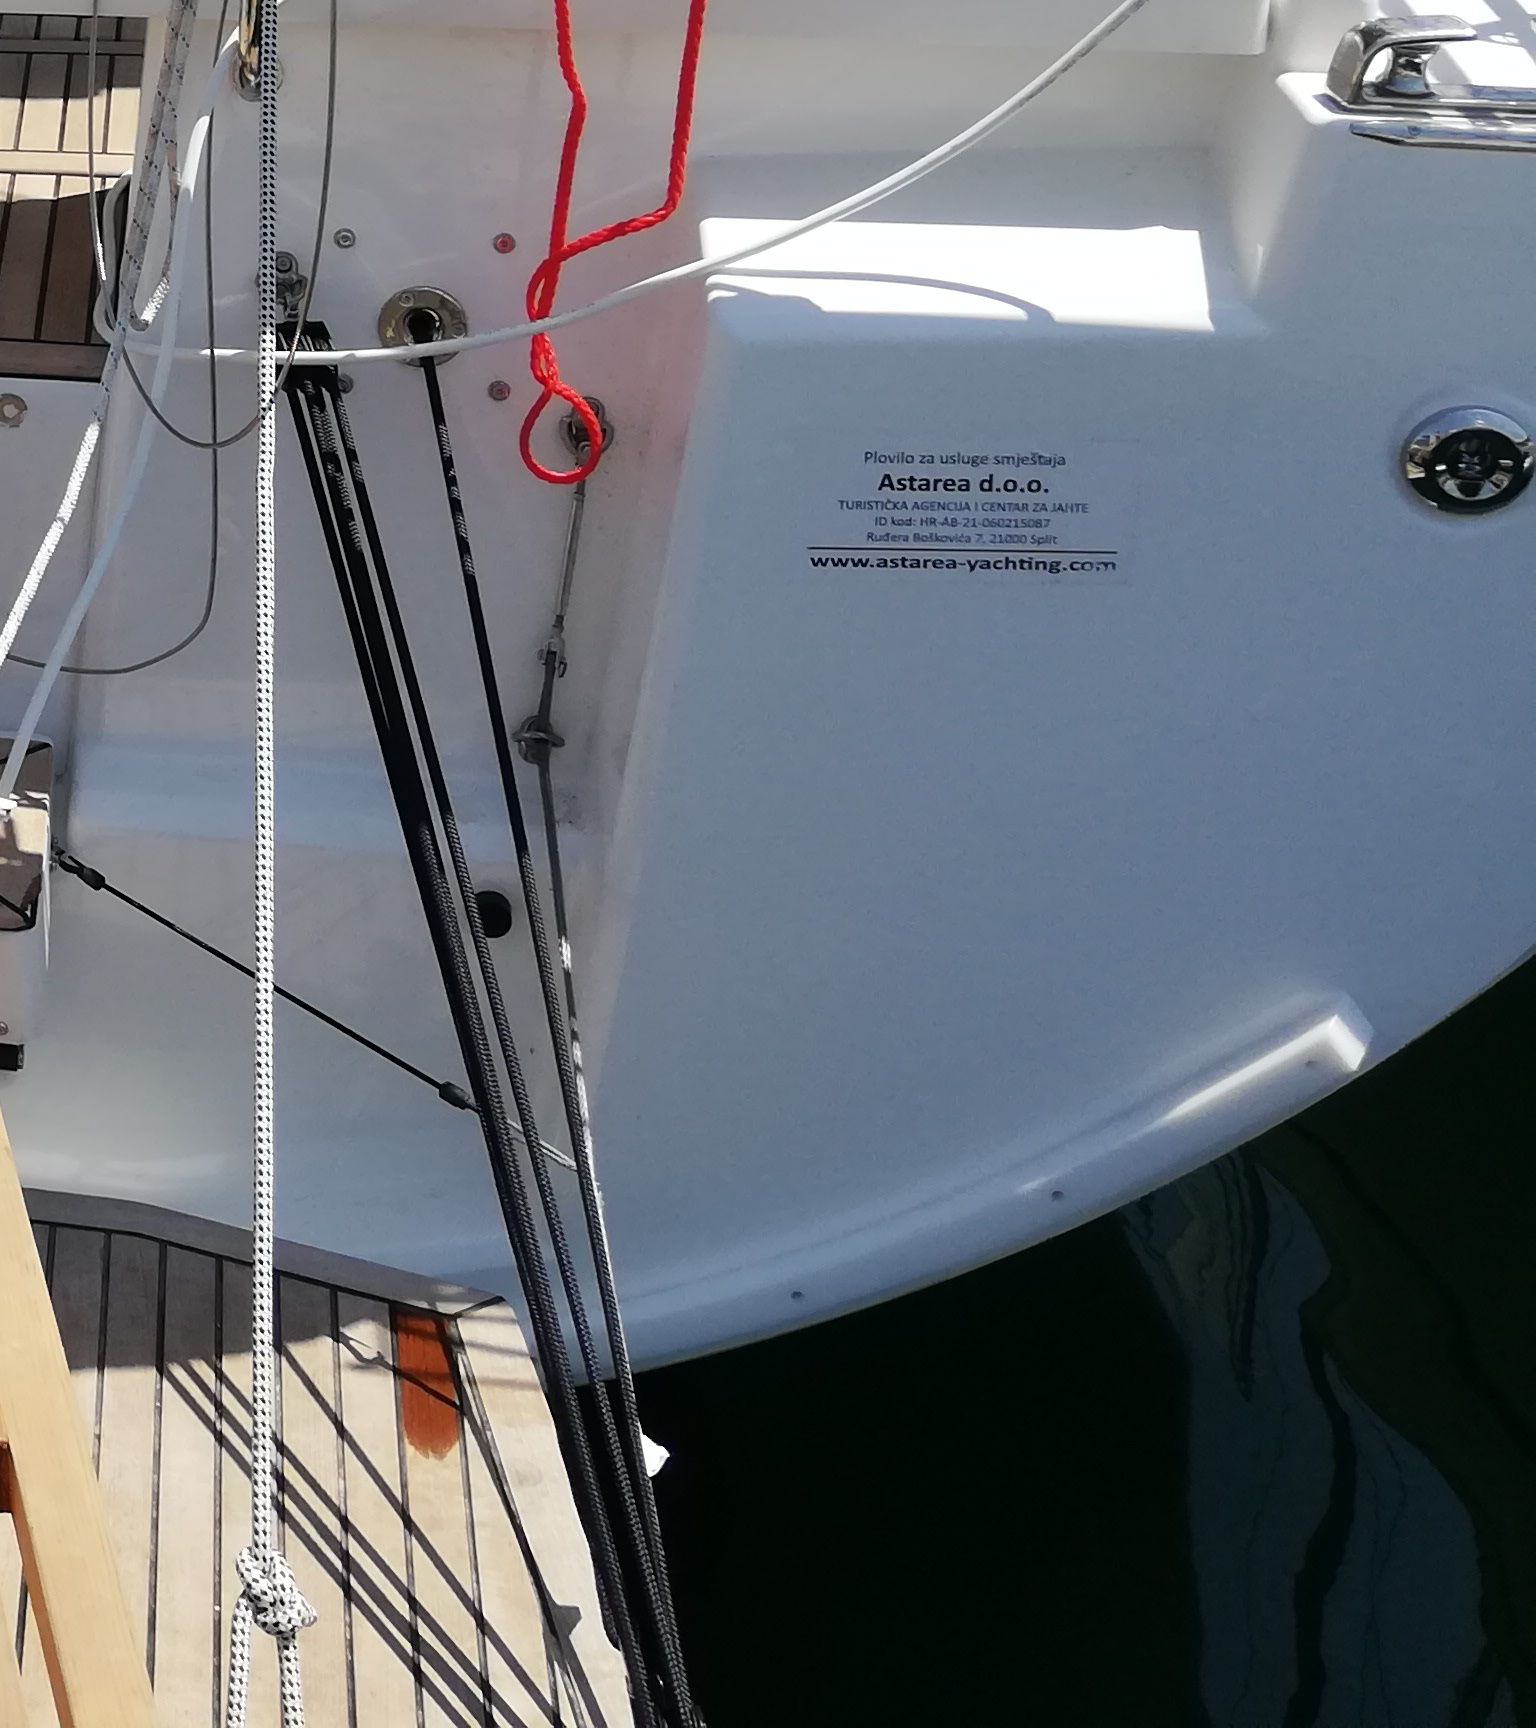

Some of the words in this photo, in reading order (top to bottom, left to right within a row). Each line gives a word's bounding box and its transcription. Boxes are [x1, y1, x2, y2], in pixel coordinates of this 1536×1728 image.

[864, 450, 915, 465] Plovilo
[919, 453, 935, 465] za
[940, 452, 989, 468] usluge
[993, 452, 1067, 468] smještaja
[878, 473, 971, 492] Astarea
[979, 473, 1049, 493] d.o.o.
[838, 498, 909, 512] TURISTIČKA
[911, 500, 972, 512] AGENCIJA
[981, 501, 1029, 513] CENTAR
[1032, 502, 1049, 513] ZA
[1050, 503, 1089, 514] JAHTE
[875, 516, 888, 527] ID
[891, 516, 916, 527] kod:
[990, 534, 1027, 545] 21000
[1030, 534, 1058, 546] Split
[810, 555, 1117, 574] www.astarea-yachting.com
